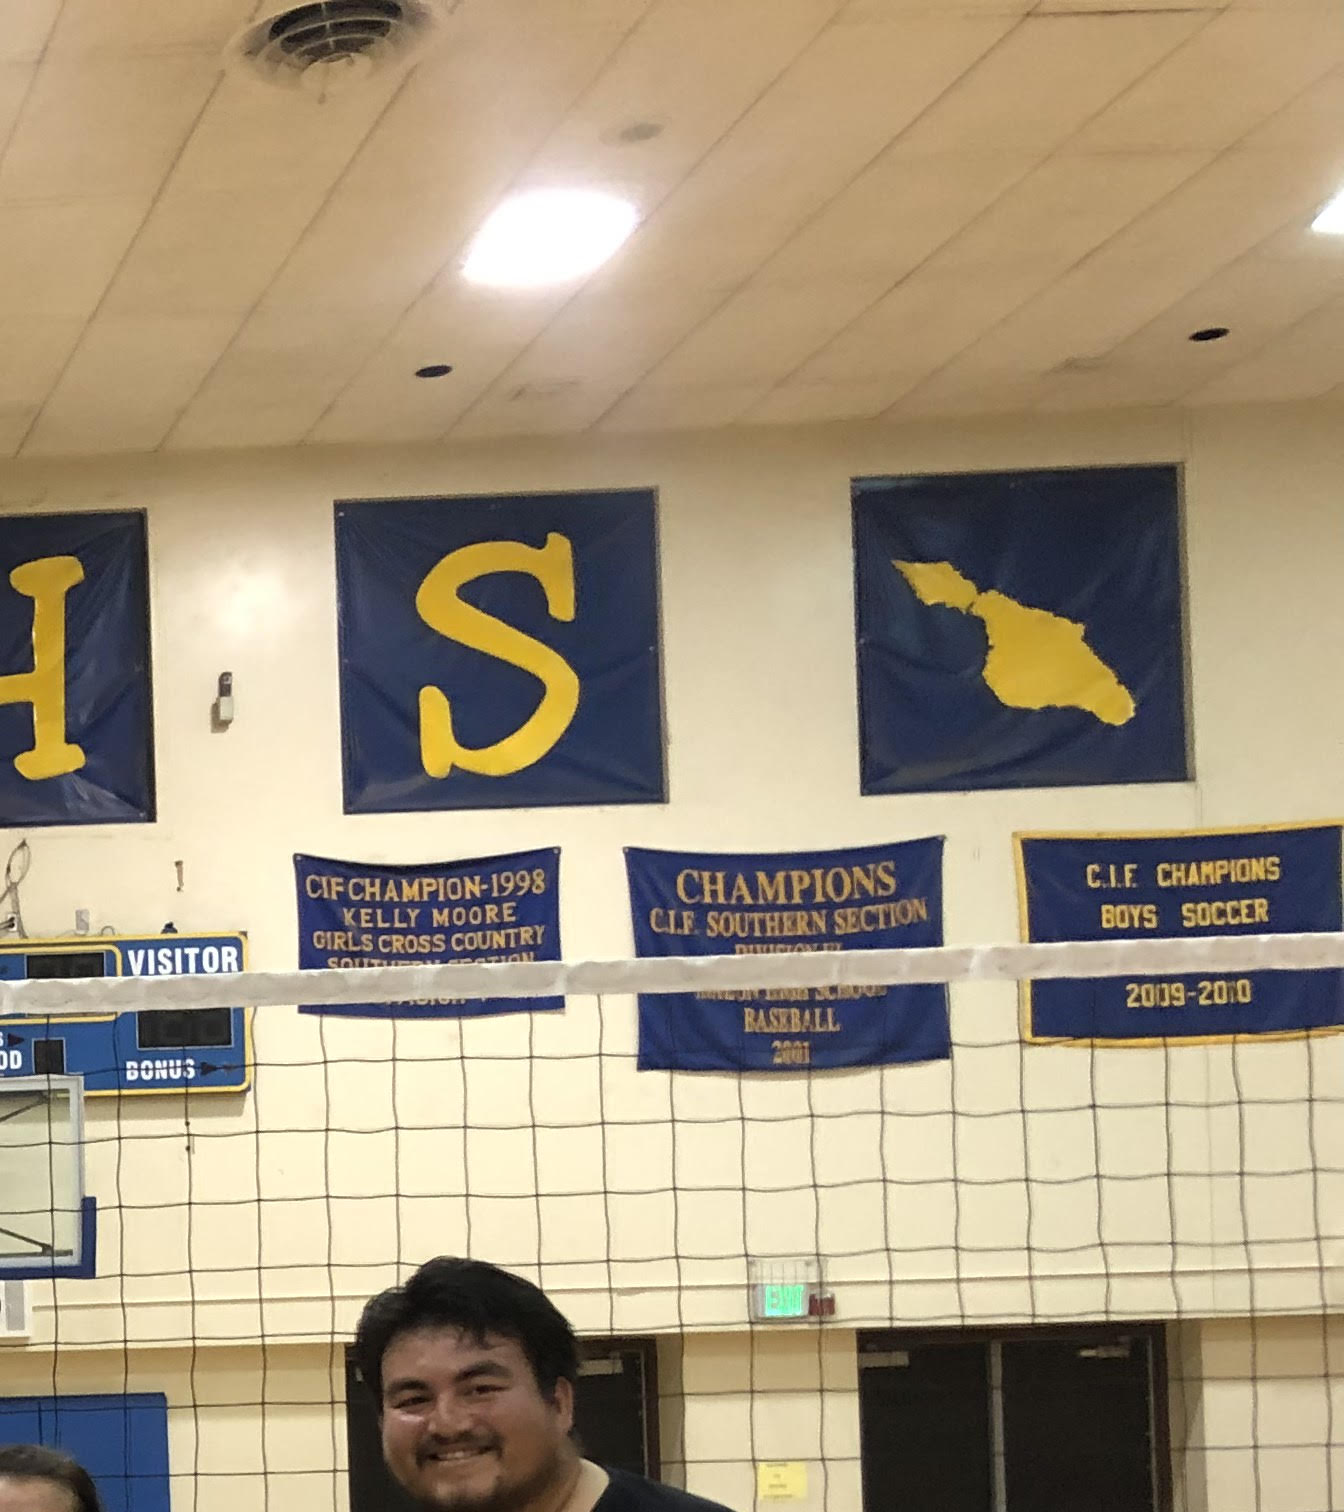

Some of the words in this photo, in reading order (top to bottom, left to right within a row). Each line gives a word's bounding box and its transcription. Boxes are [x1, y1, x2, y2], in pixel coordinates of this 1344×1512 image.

[415, 532, 579, 779] S
[306, 874, 344, 901] CIF
[348, 869, 545, 902] CHAMPION-1998
[677, 861, 896, 905] CHAMPIONS
[1156, 857, 1281, 887] CHAMPIONS
[343, 907, 420, 928] KELLY
[433, 902, 516, 928] MOORE
[707, 909, 825, 937] SOUTHERN
[834, 898, 928, 936] SECTION
[1101, 905, 1157, 929] BOYS
[1182, 899, 1269, 928] SOCCER
[313, 931, 373, 952] GIRLS
[379, 934, 445, 954] CROSS
[451, 925, 545, 951] COUNTRY
[128, 946, 238, 976] VISITOR
[744, 1007, 840, 1033] BASEBALL
[126, 1059, 195, 1081] BONUS
